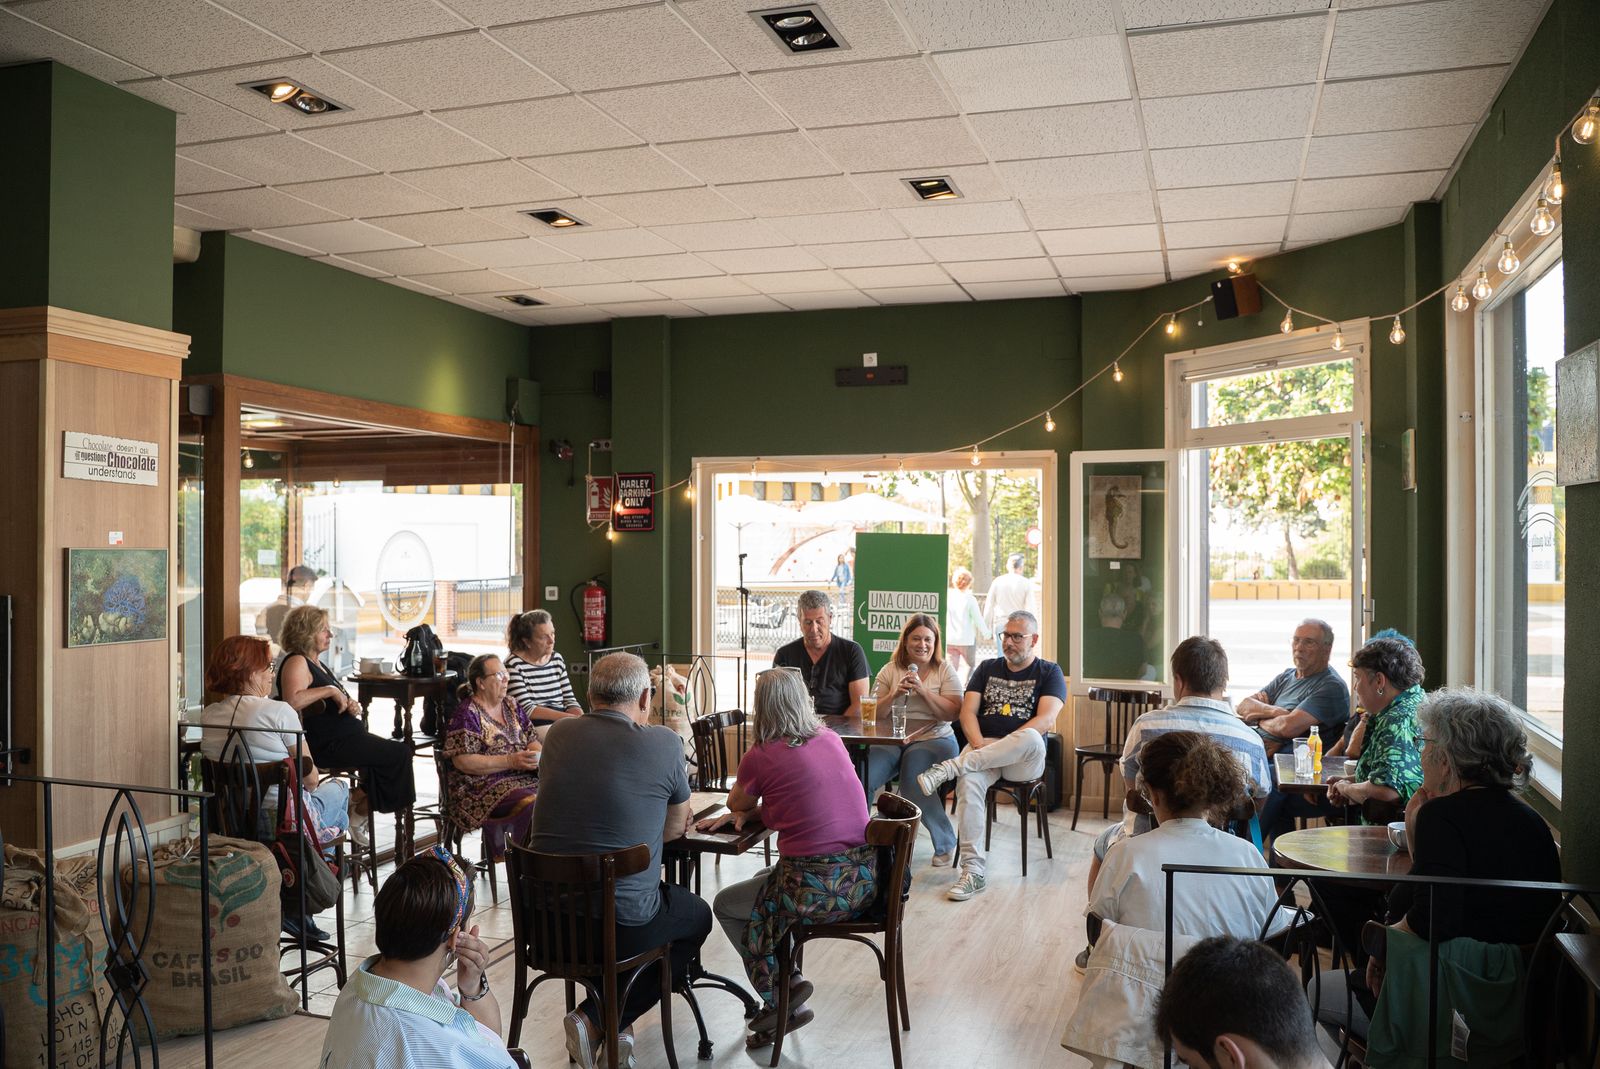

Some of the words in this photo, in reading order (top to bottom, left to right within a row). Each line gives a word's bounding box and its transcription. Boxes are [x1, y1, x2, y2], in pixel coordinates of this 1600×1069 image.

[82, 437, 113, 451] Chocolate
[107, 451, 156, 471] Chocolate
[88, 466, 137, 480] understands
[620, 479, 649, 488] HARLEY
[625, 497, 644, 507] ONLY
[871, 592, 893, 608] UNA
[896, 593, 938, 610] CIUDAD
[870, 614, 901, 629] PARA
[236, 943, 263, 962] DO
[76, 1048, 95, 1067] OF
